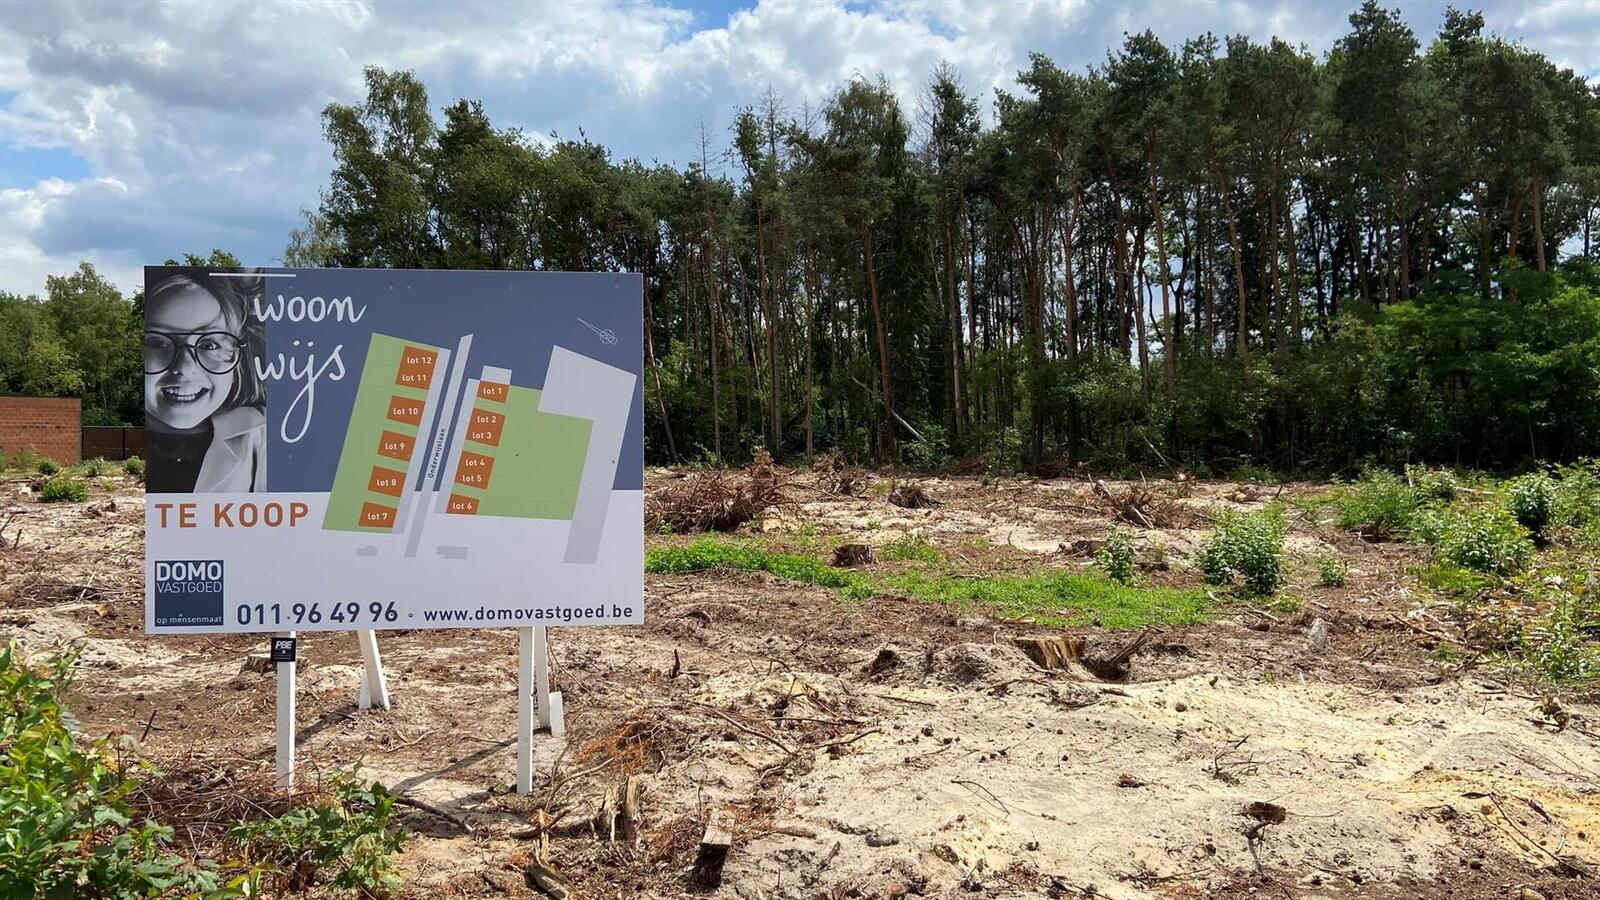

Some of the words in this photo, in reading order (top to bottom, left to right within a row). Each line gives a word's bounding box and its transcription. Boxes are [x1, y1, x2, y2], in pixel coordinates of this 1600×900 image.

[253, 294, 367, 323] woon
[406, 356, 419, 364] lot
[422, 356, 432, 364] 12
[402, 374, 414, 382] lot
[417, 374, 427, 382] 11
[254, 340, 346, 443] wijs
[483, 387, 495, 395] lot
[498, 387, 502, 395] 1
[393, 407, 405, 415] lot
[408, 407, 419, 415] 10
[385, 442, 397, 450] lot
[400, 442, 405, 450] 9
[428, 428, 446, 478] Onderwijslaan
[462, 474, 474, 482] lot
[476, 474, 482, 482] 5
[452, 502, 464, 510] lot
[467, 502, 472, 510] 6
[154, 503, 197, 528] TE
[214, 502, 309, 528] KOOP
[367, 512, 380, 520] lot
[382, 512, 388, 520] 7
[156, 562, 222, 581] DOMO
[156, 581, 222, 593] VASTGOED
[237, 604, 280, 625] 011
[292, 603, 322, 624] 96
[330, 602, 360, 623] 49
[369, 601, 398, 622] 96
[424, 604, 633, 621] www.domovastgoed.be
